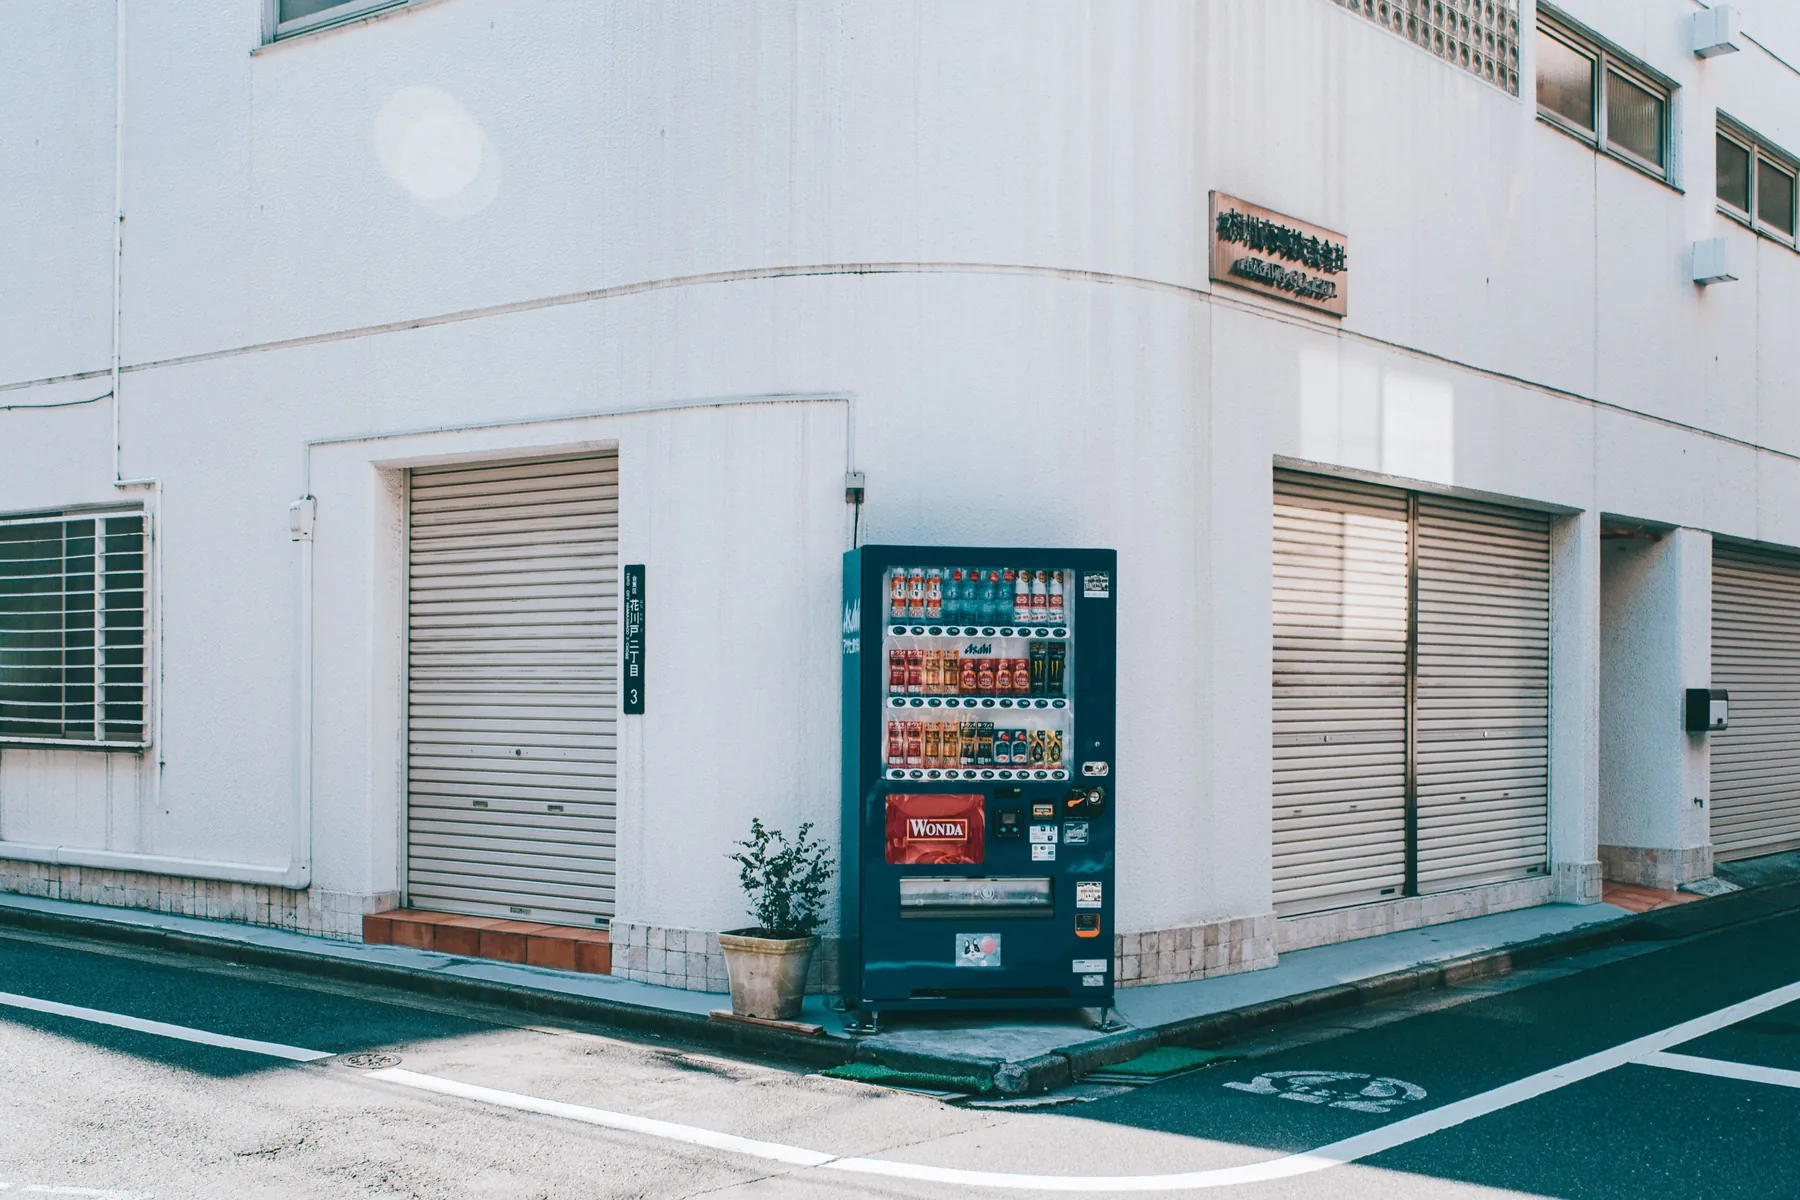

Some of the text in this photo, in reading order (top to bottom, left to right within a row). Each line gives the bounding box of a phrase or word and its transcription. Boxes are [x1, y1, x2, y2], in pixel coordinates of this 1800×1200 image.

[629, 598, 639, 677] 花川戸二丁目
[964, 643, 992, 655] Asahi
[630, 688, 638, 705] 3
[909, 819, 964, 837] WONDA
